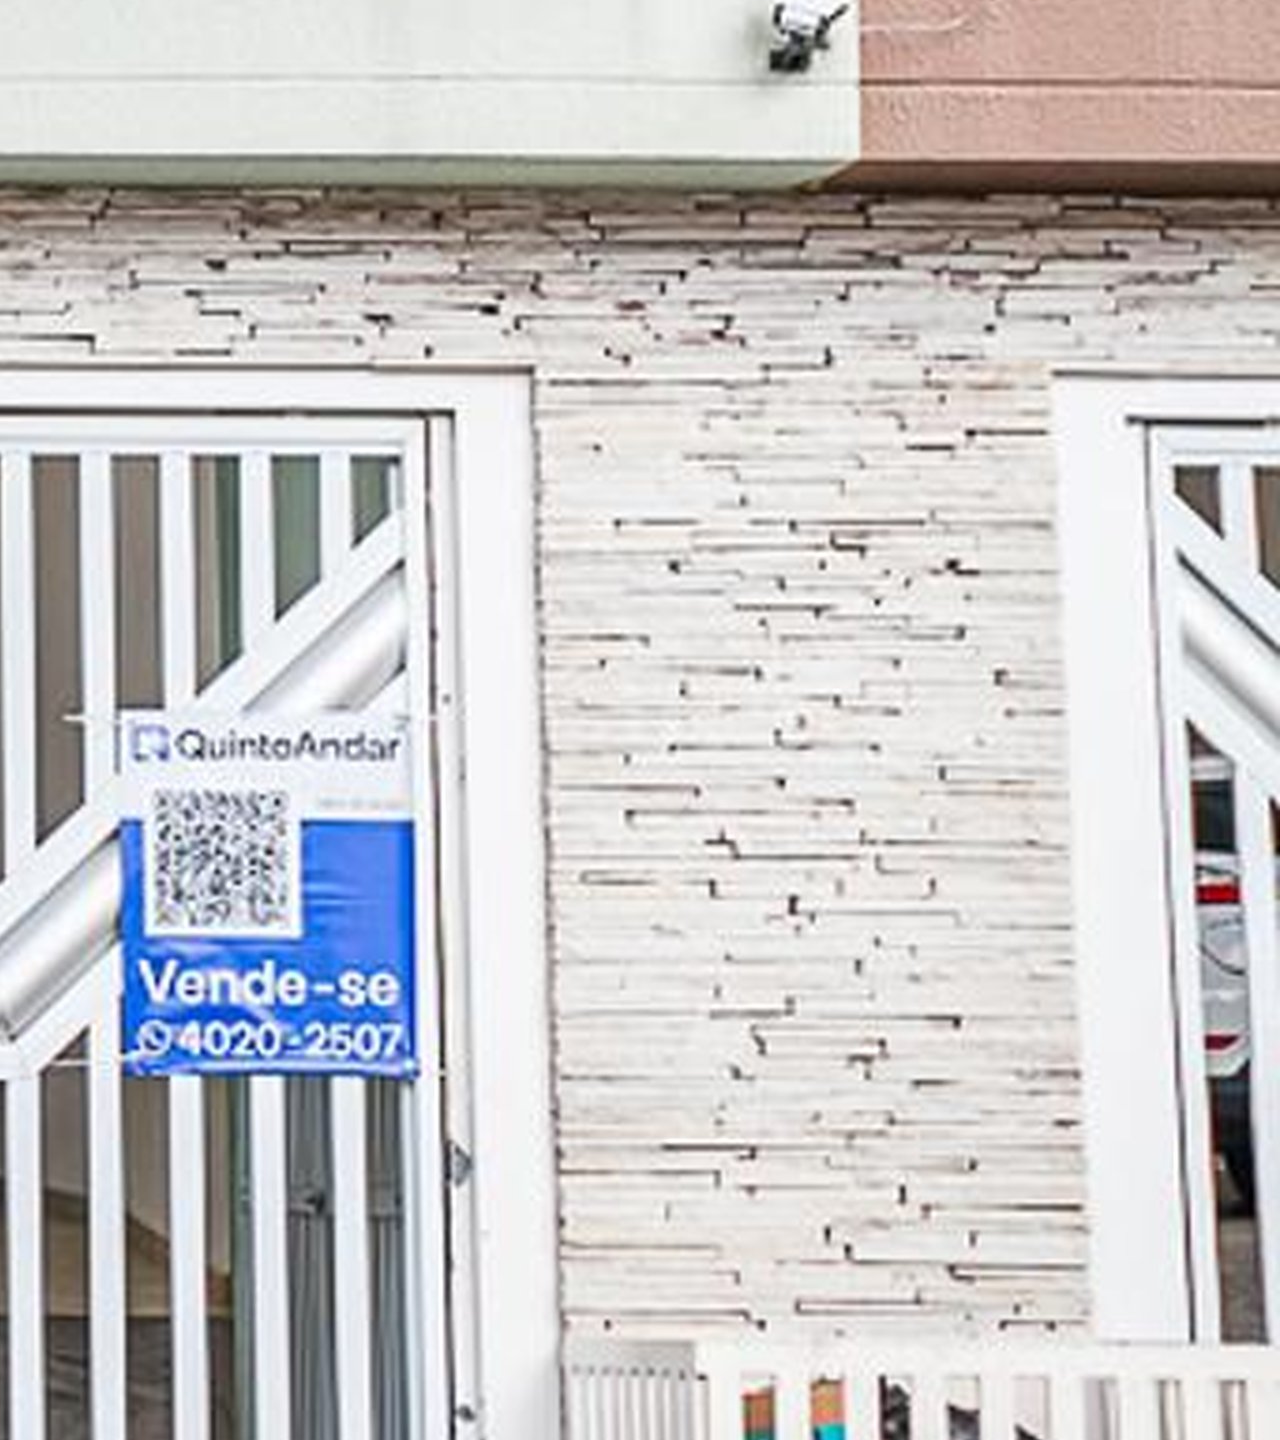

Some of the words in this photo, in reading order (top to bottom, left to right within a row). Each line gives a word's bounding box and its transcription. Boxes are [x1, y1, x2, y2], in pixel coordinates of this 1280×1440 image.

[174, 728, 400, 763] QuintoAndar
[138, 958, 400, 1008] Vende-se
[180, 1022, 403, 1060] 4020-2507
